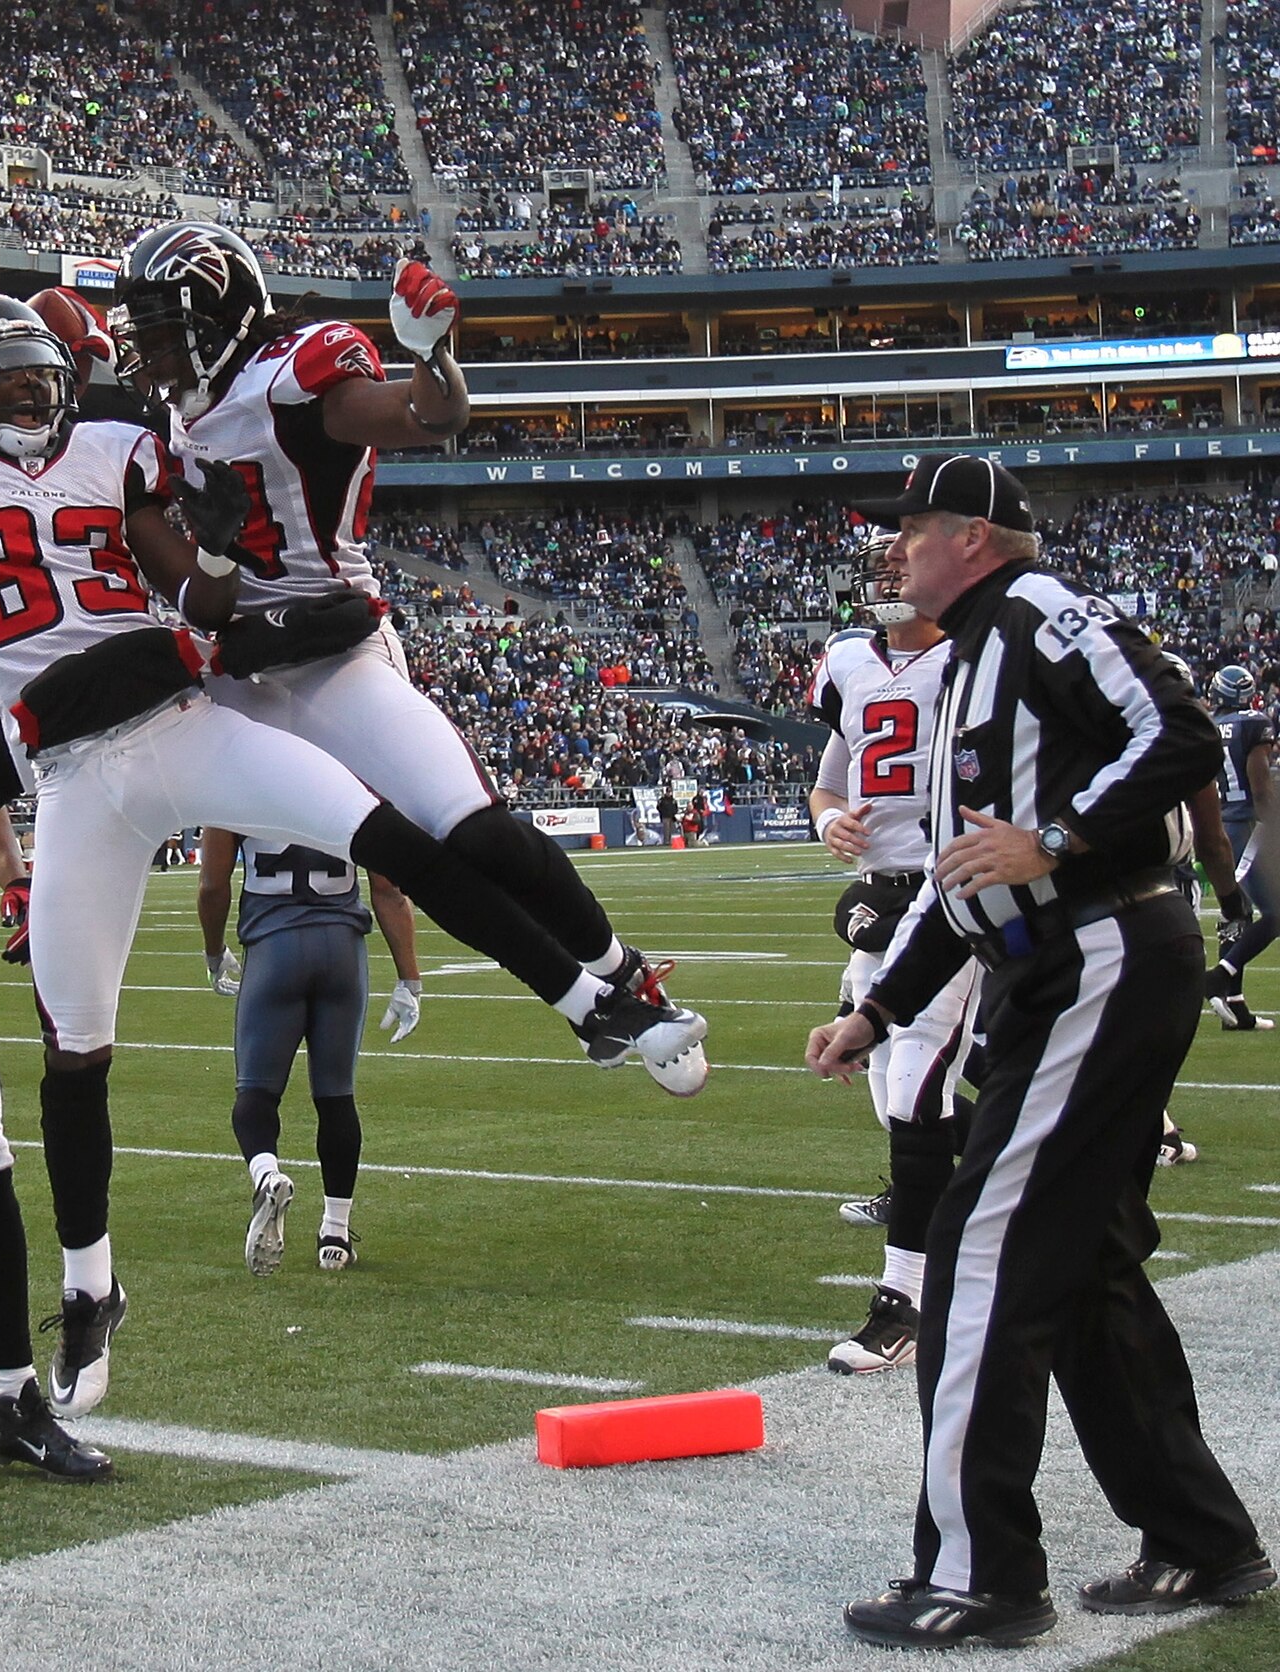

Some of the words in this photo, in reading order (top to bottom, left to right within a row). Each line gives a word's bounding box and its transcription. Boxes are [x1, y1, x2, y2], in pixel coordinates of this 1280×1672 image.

[486, 460, 742, 481] WELCOME
[794, 457, 848, 472] TO
[902, 447, 1080, 469] QEST
[11, 490, 66, 499] FALCONS
[1045, 599, 1113, 650] 134
[860, 698, 919, 799] 2
[637, 800, 661, 824] 12
[704, 789, 726, 812] 12
[321, 1248, 345, 1262] NIKE
